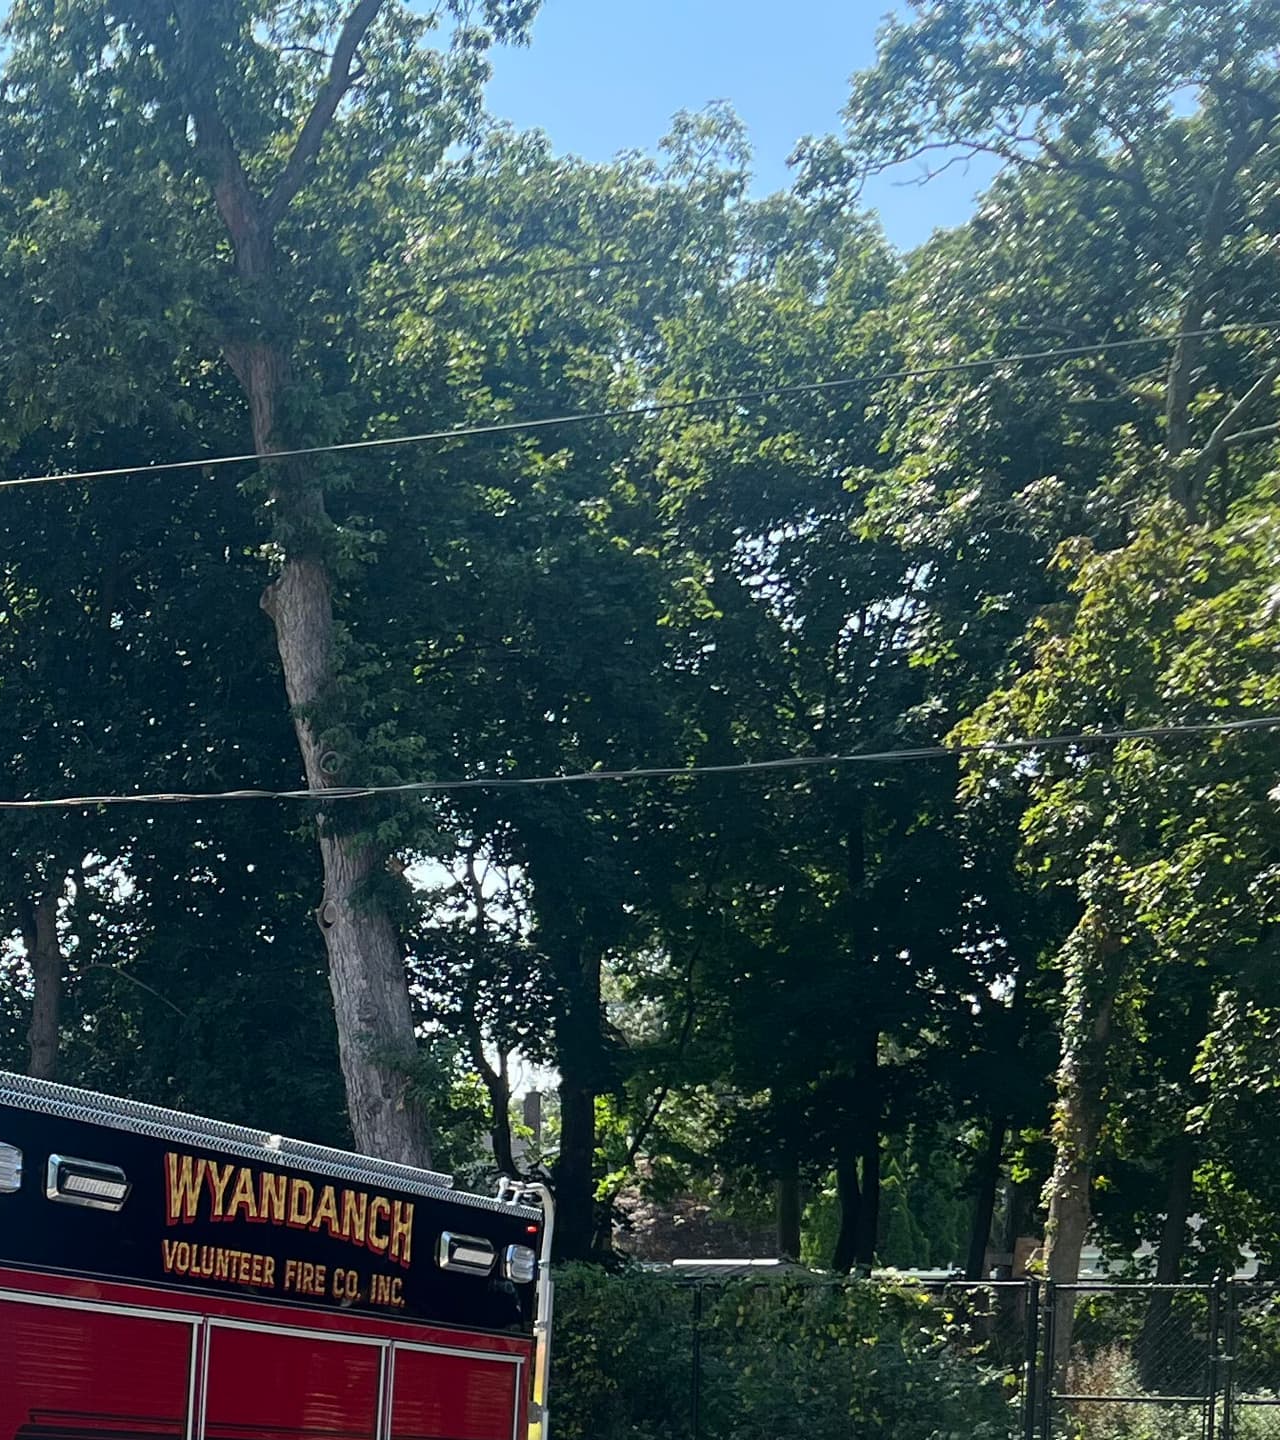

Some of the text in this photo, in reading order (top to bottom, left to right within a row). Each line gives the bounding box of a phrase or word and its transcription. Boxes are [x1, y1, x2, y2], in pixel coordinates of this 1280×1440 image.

[163, 1152, 415, 1268] WYANDANCH
[162, 1239, 406, 1307] VOLUNTEER FIRE CO. INC.
